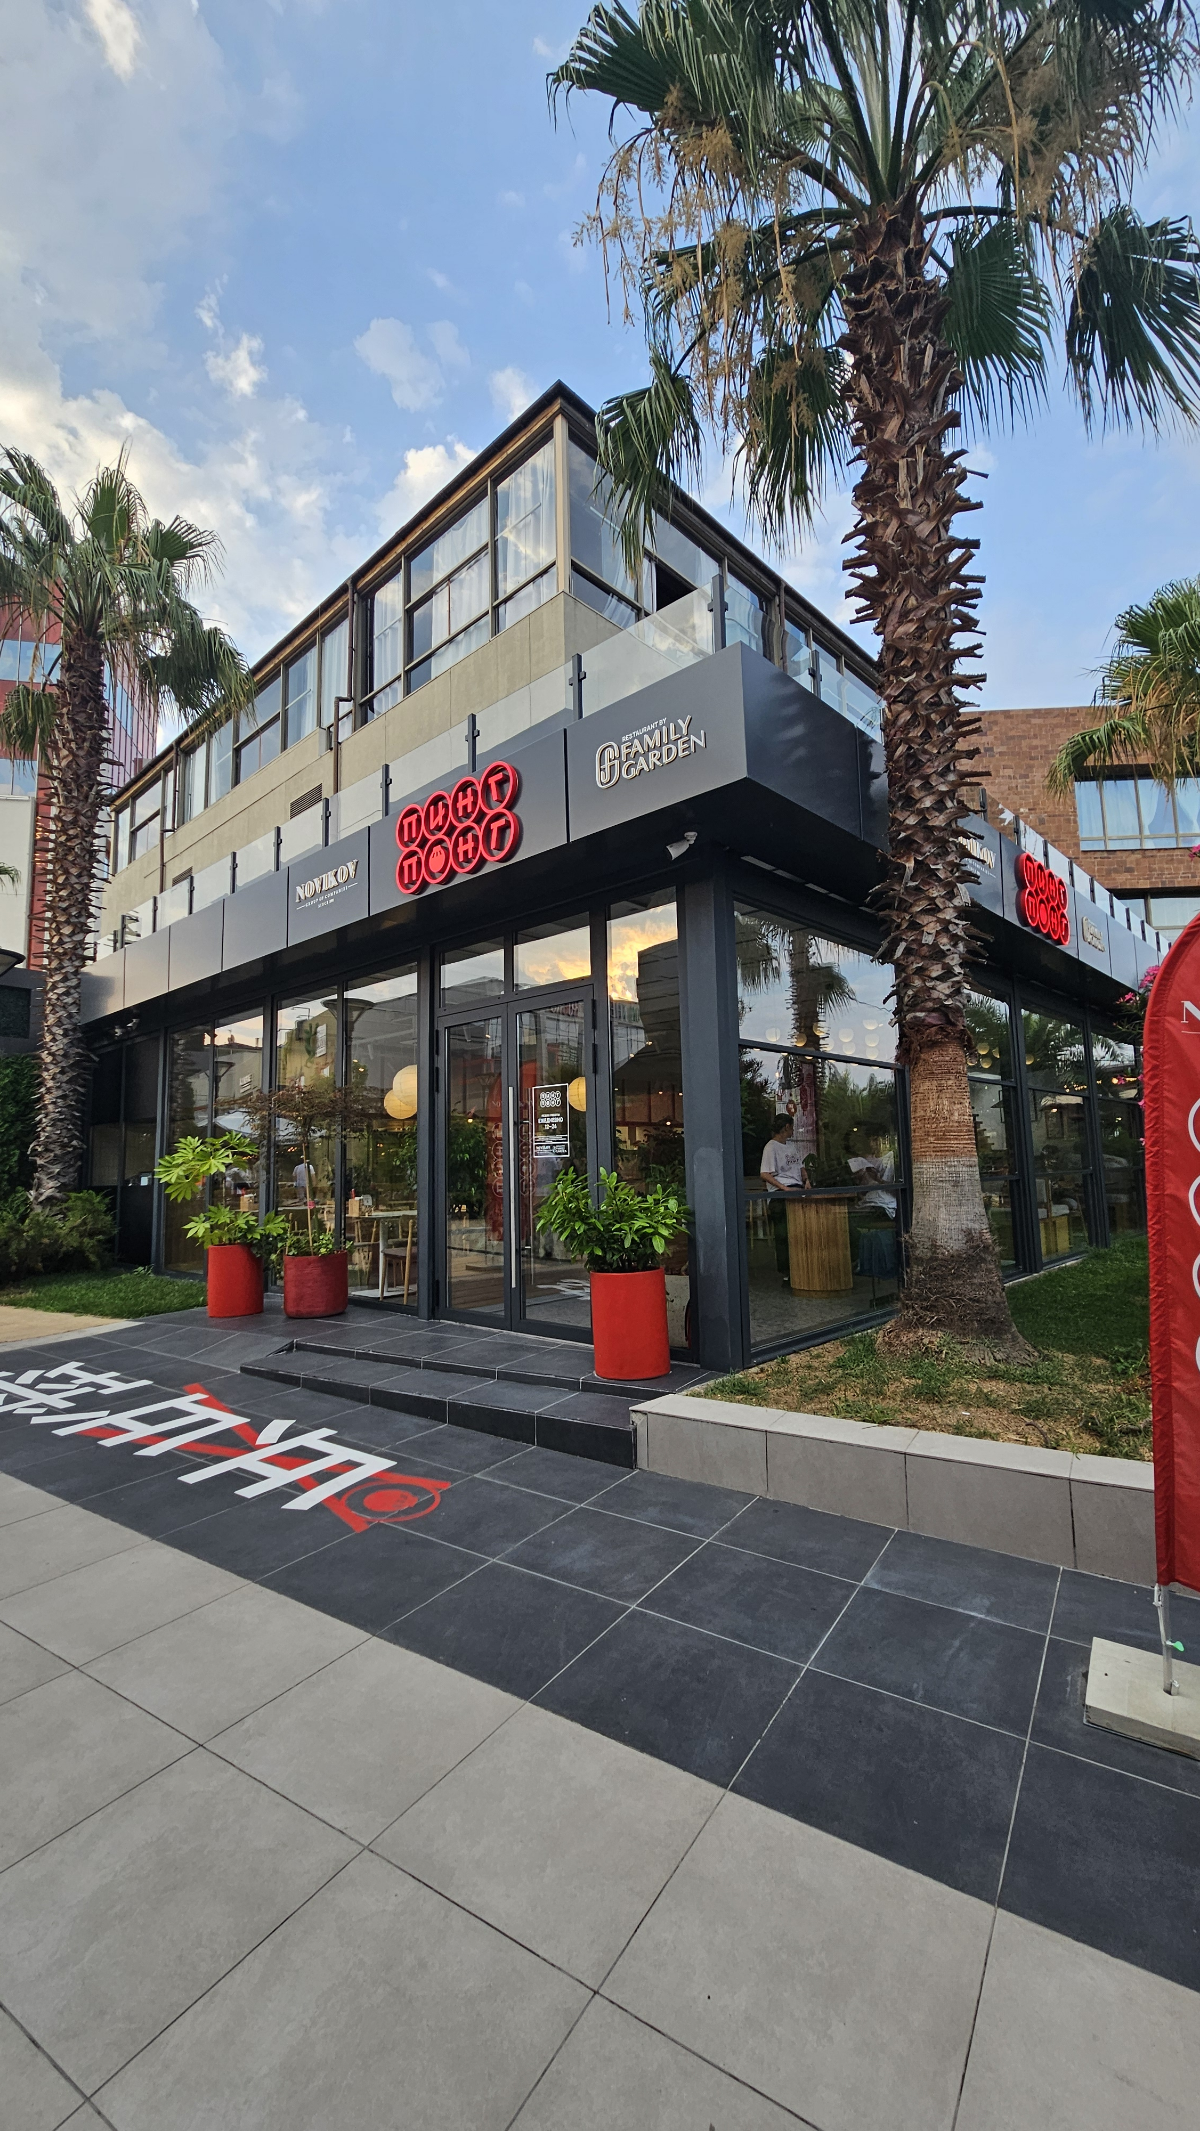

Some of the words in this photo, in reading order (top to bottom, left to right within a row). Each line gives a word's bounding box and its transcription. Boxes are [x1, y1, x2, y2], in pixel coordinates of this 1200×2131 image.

[621, 720, 659, 742] RESTAURANT
[658, 717, 667, 726] BY
[621, 714, 692, 762] FAMILY
[621, 729, 707, 780] GARDEN
[400, 767, 509, 844] ПИНГ
[295, 859, 359, 903] NOVIKOV
